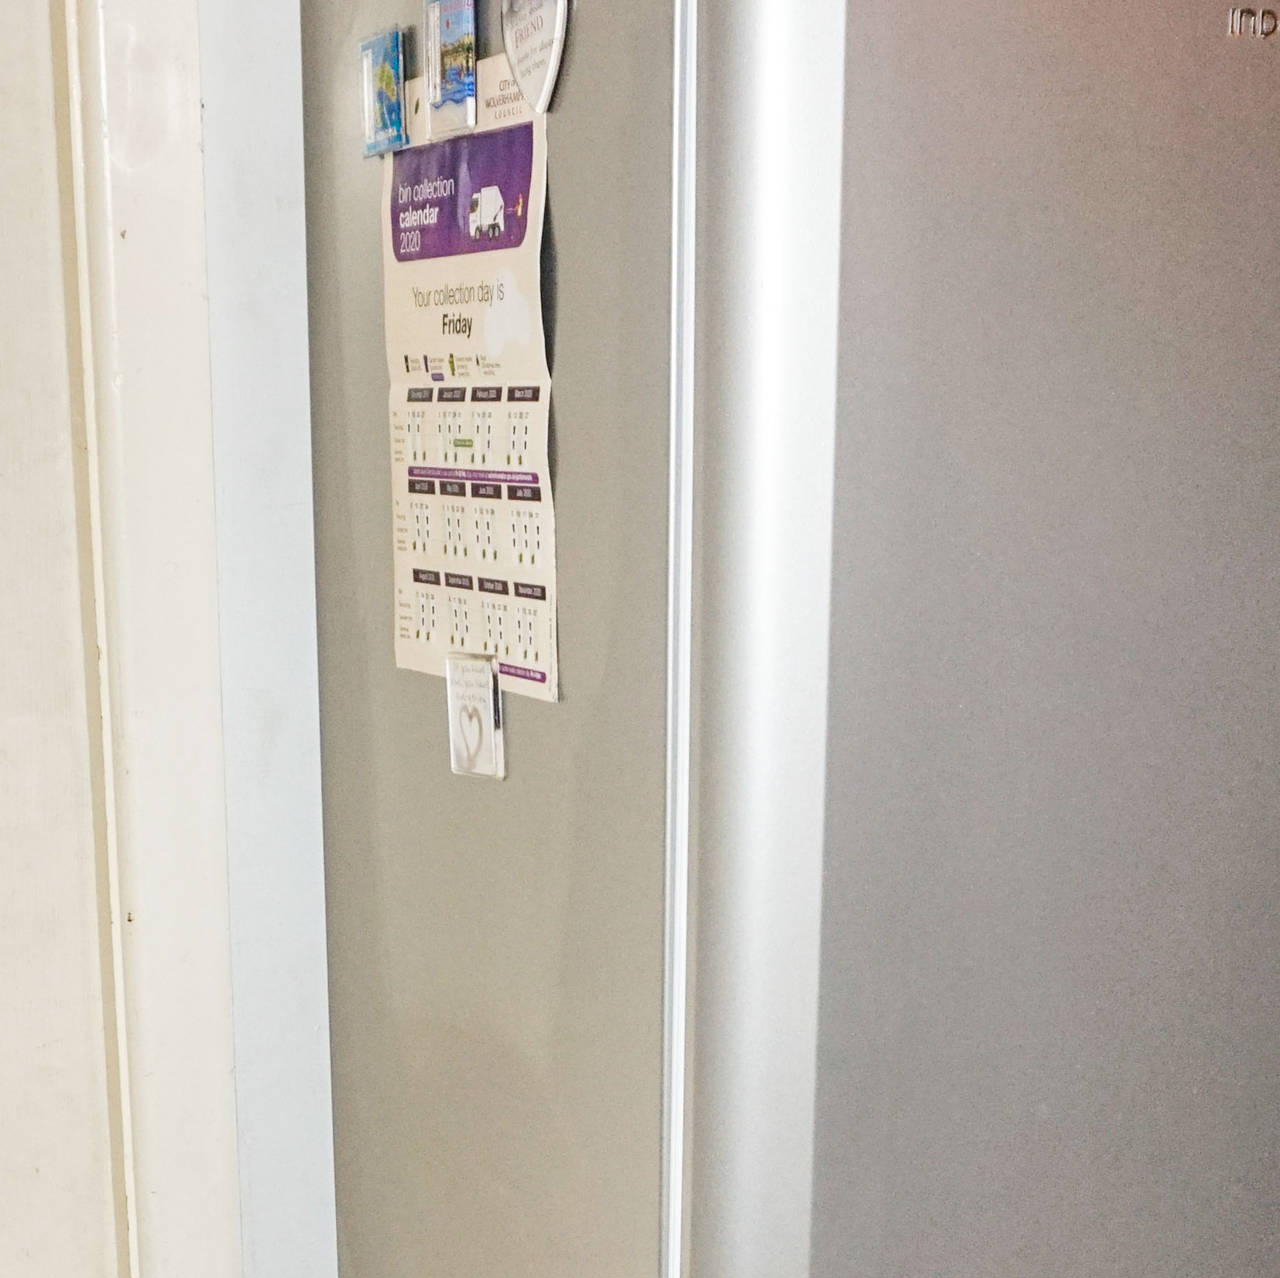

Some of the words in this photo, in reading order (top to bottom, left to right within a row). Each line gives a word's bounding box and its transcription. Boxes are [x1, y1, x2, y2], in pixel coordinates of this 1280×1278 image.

[399, 182, 412, 203] bin
[413, 175, 455, 201] collection
[399, 203, 439, 228] calendar
[400, 230, 420, 253] 2020
[412, 286, 431, 308] Your
[433, 283, 475, 306] collection
[478, 280, 494, 307] day
[496, 281, 505, 301] is
[442, 312, 472, 339] Friday
